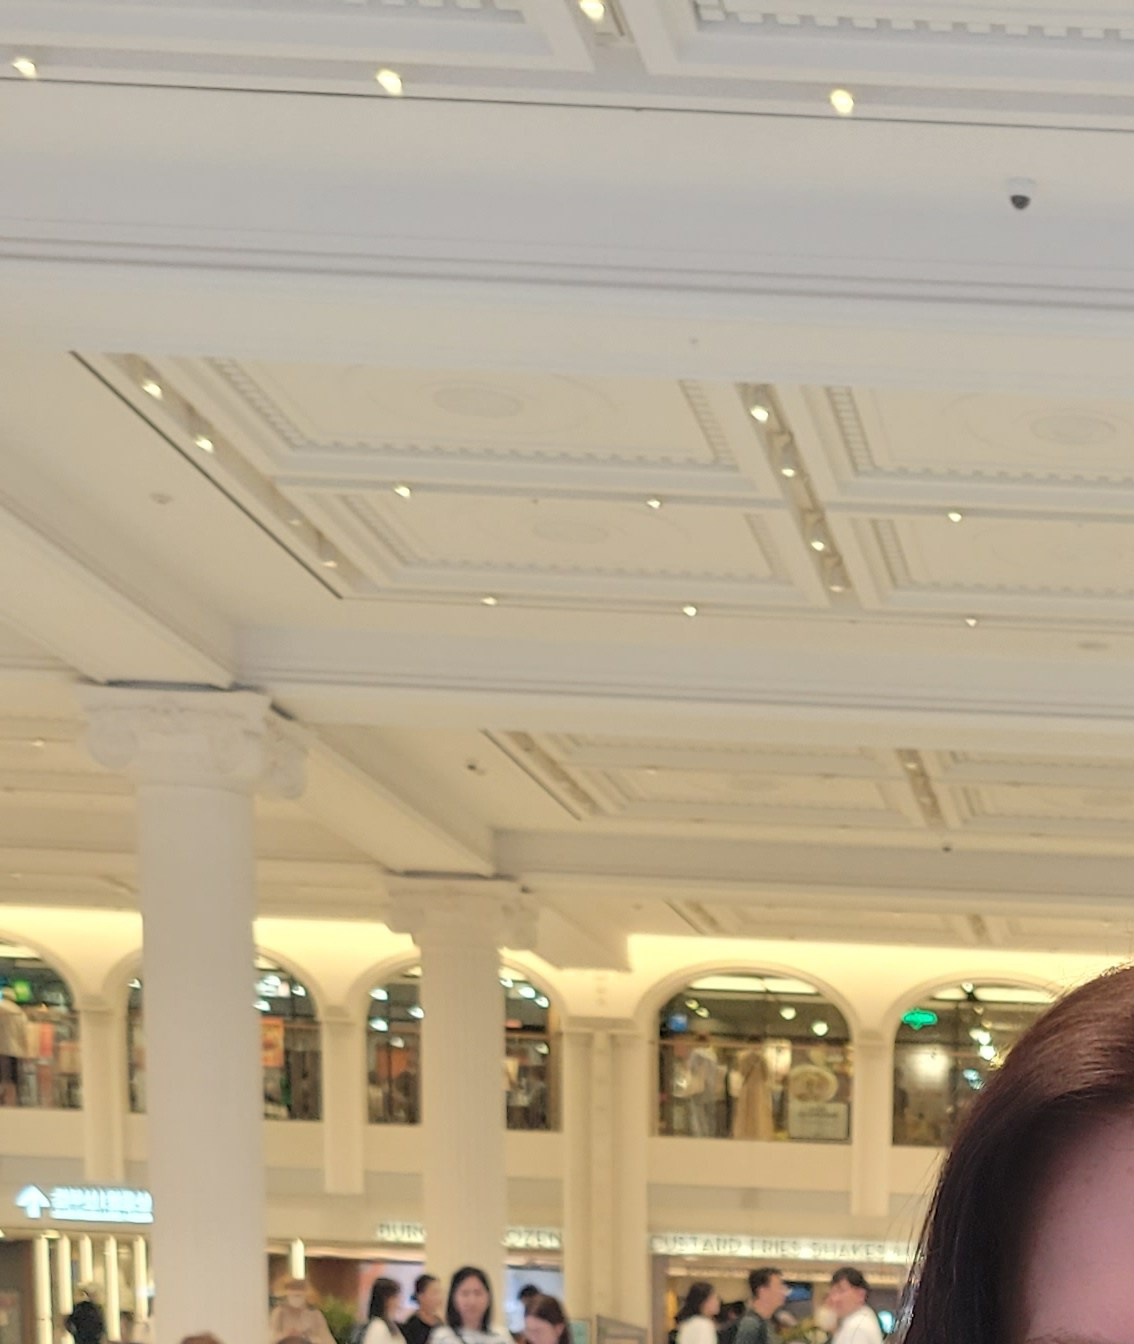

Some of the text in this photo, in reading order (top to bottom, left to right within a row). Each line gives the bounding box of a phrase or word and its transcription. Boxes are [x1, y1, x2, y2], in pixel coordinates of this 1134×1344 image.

[502, 1228, 562, 1247] OZEN
[650, 1234, 742, 1255] CUSTARD
[749, 1237, 798, 1257] FRIES
[811, 1240, 884, 1260] SHAKES
